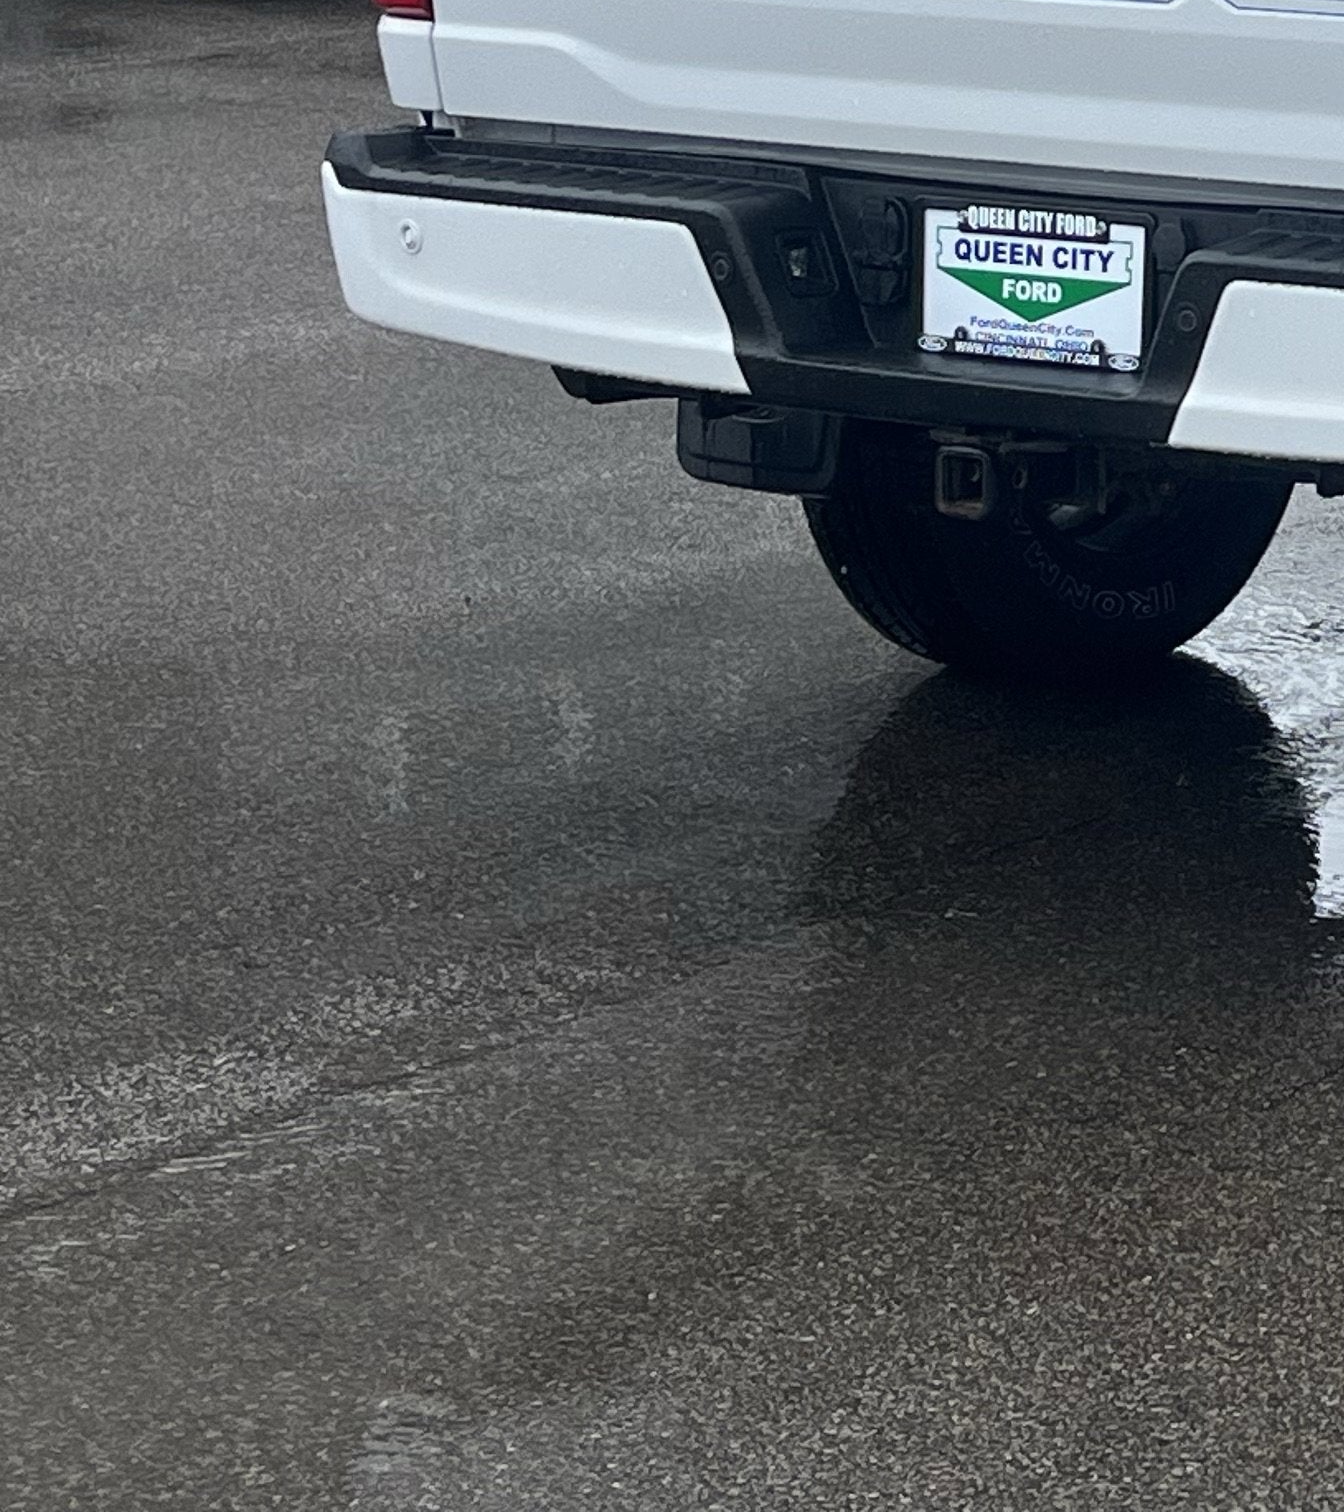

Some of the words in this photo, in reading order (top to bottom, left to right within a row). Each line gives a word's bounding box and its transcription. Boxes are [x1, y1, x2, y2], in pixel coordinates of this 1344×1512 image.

[967, 205, 1015, 232] QUEEN
[1018, 209, 1053, 234] CITY
[1056, 213, 1097, 237] FORD
[954, 238, 1043, 267] QUEEN
[1052, 247, 1115, 273] CITY
[1002, 279, 1062, 303] FORD
